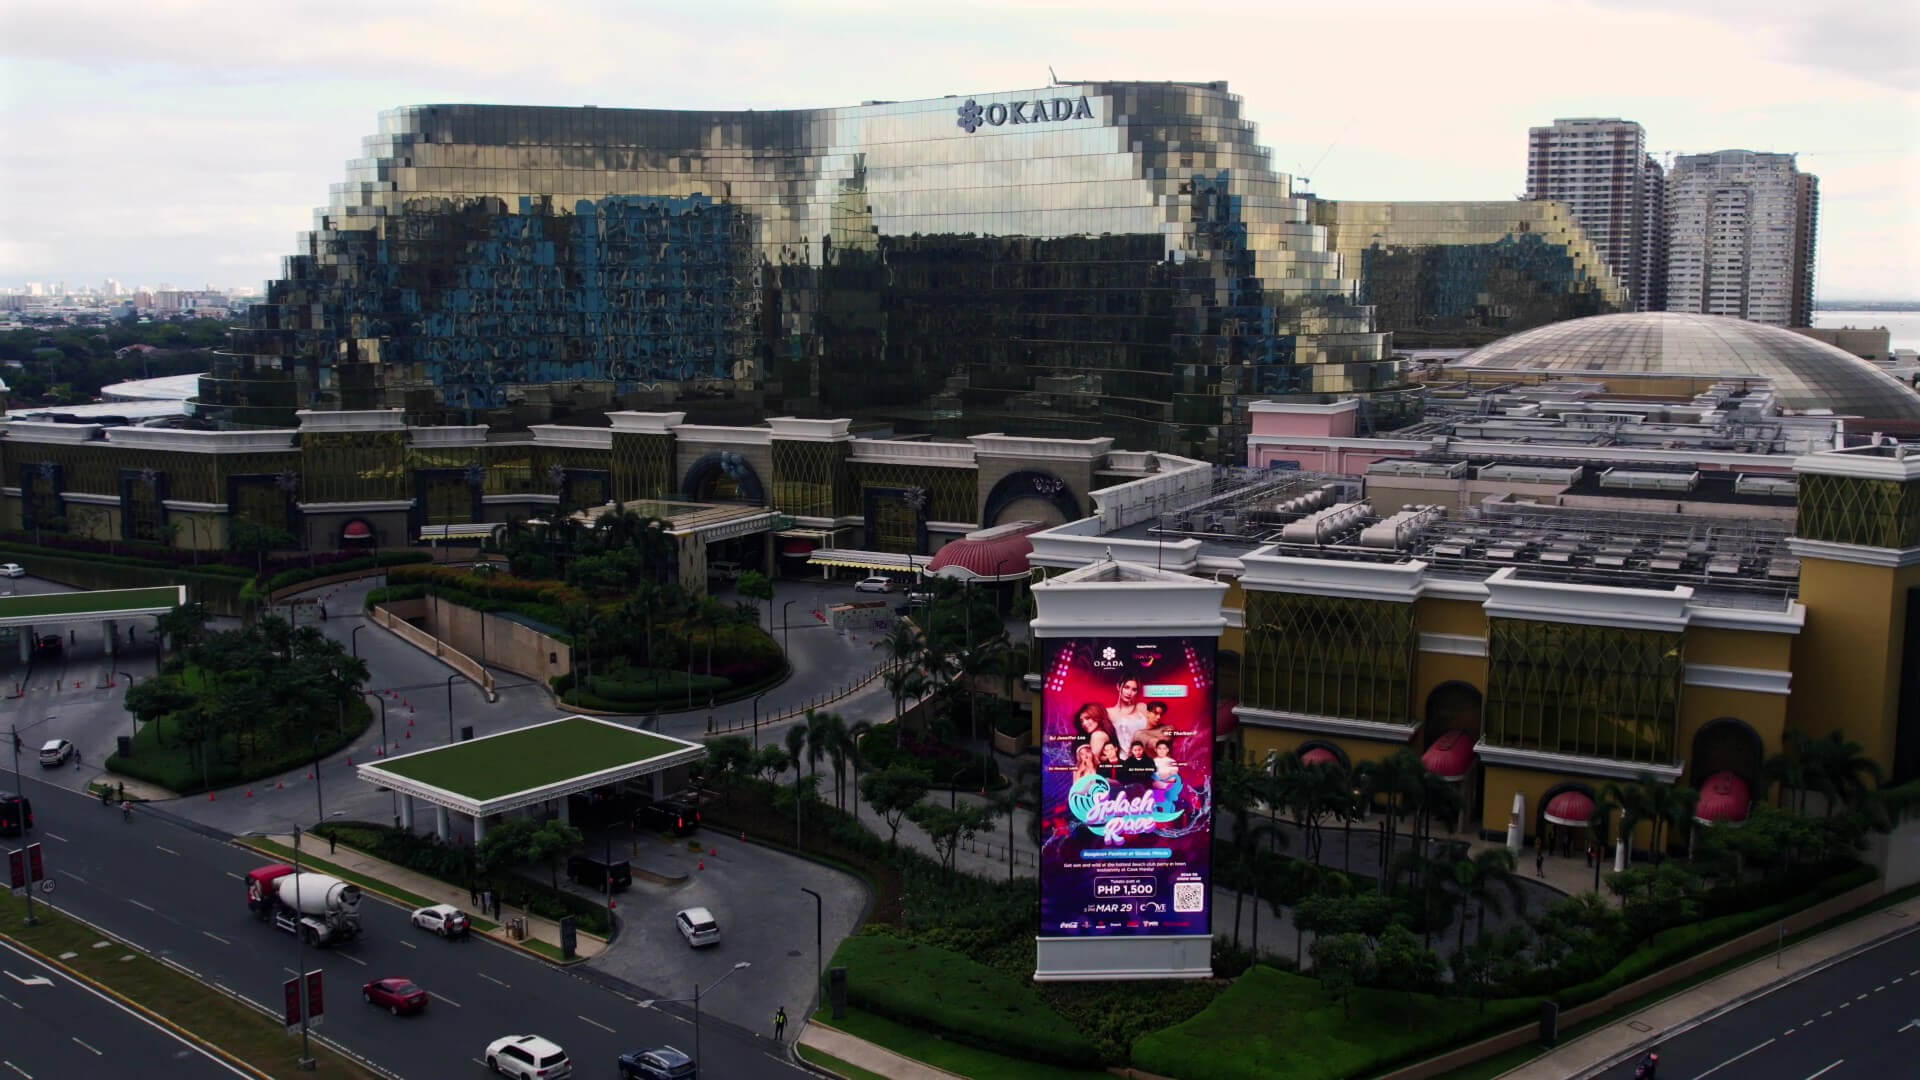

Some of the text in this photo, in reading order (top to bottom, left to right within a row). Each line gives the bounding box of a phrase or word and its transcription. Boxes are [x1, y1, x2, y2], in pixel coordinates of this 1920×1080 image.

[985, 95, 1095, 126] OKADA
[1085, 789, 1155, 822] Splash
[1103, 816, 1156, 846] Rave
[43, 881, 54, 889] 40
[1097, 884, 1153, 896] PHP 1,500
[1096, 903, 1119, 913] MAR
[1120, 903, 1133, 912] 29
